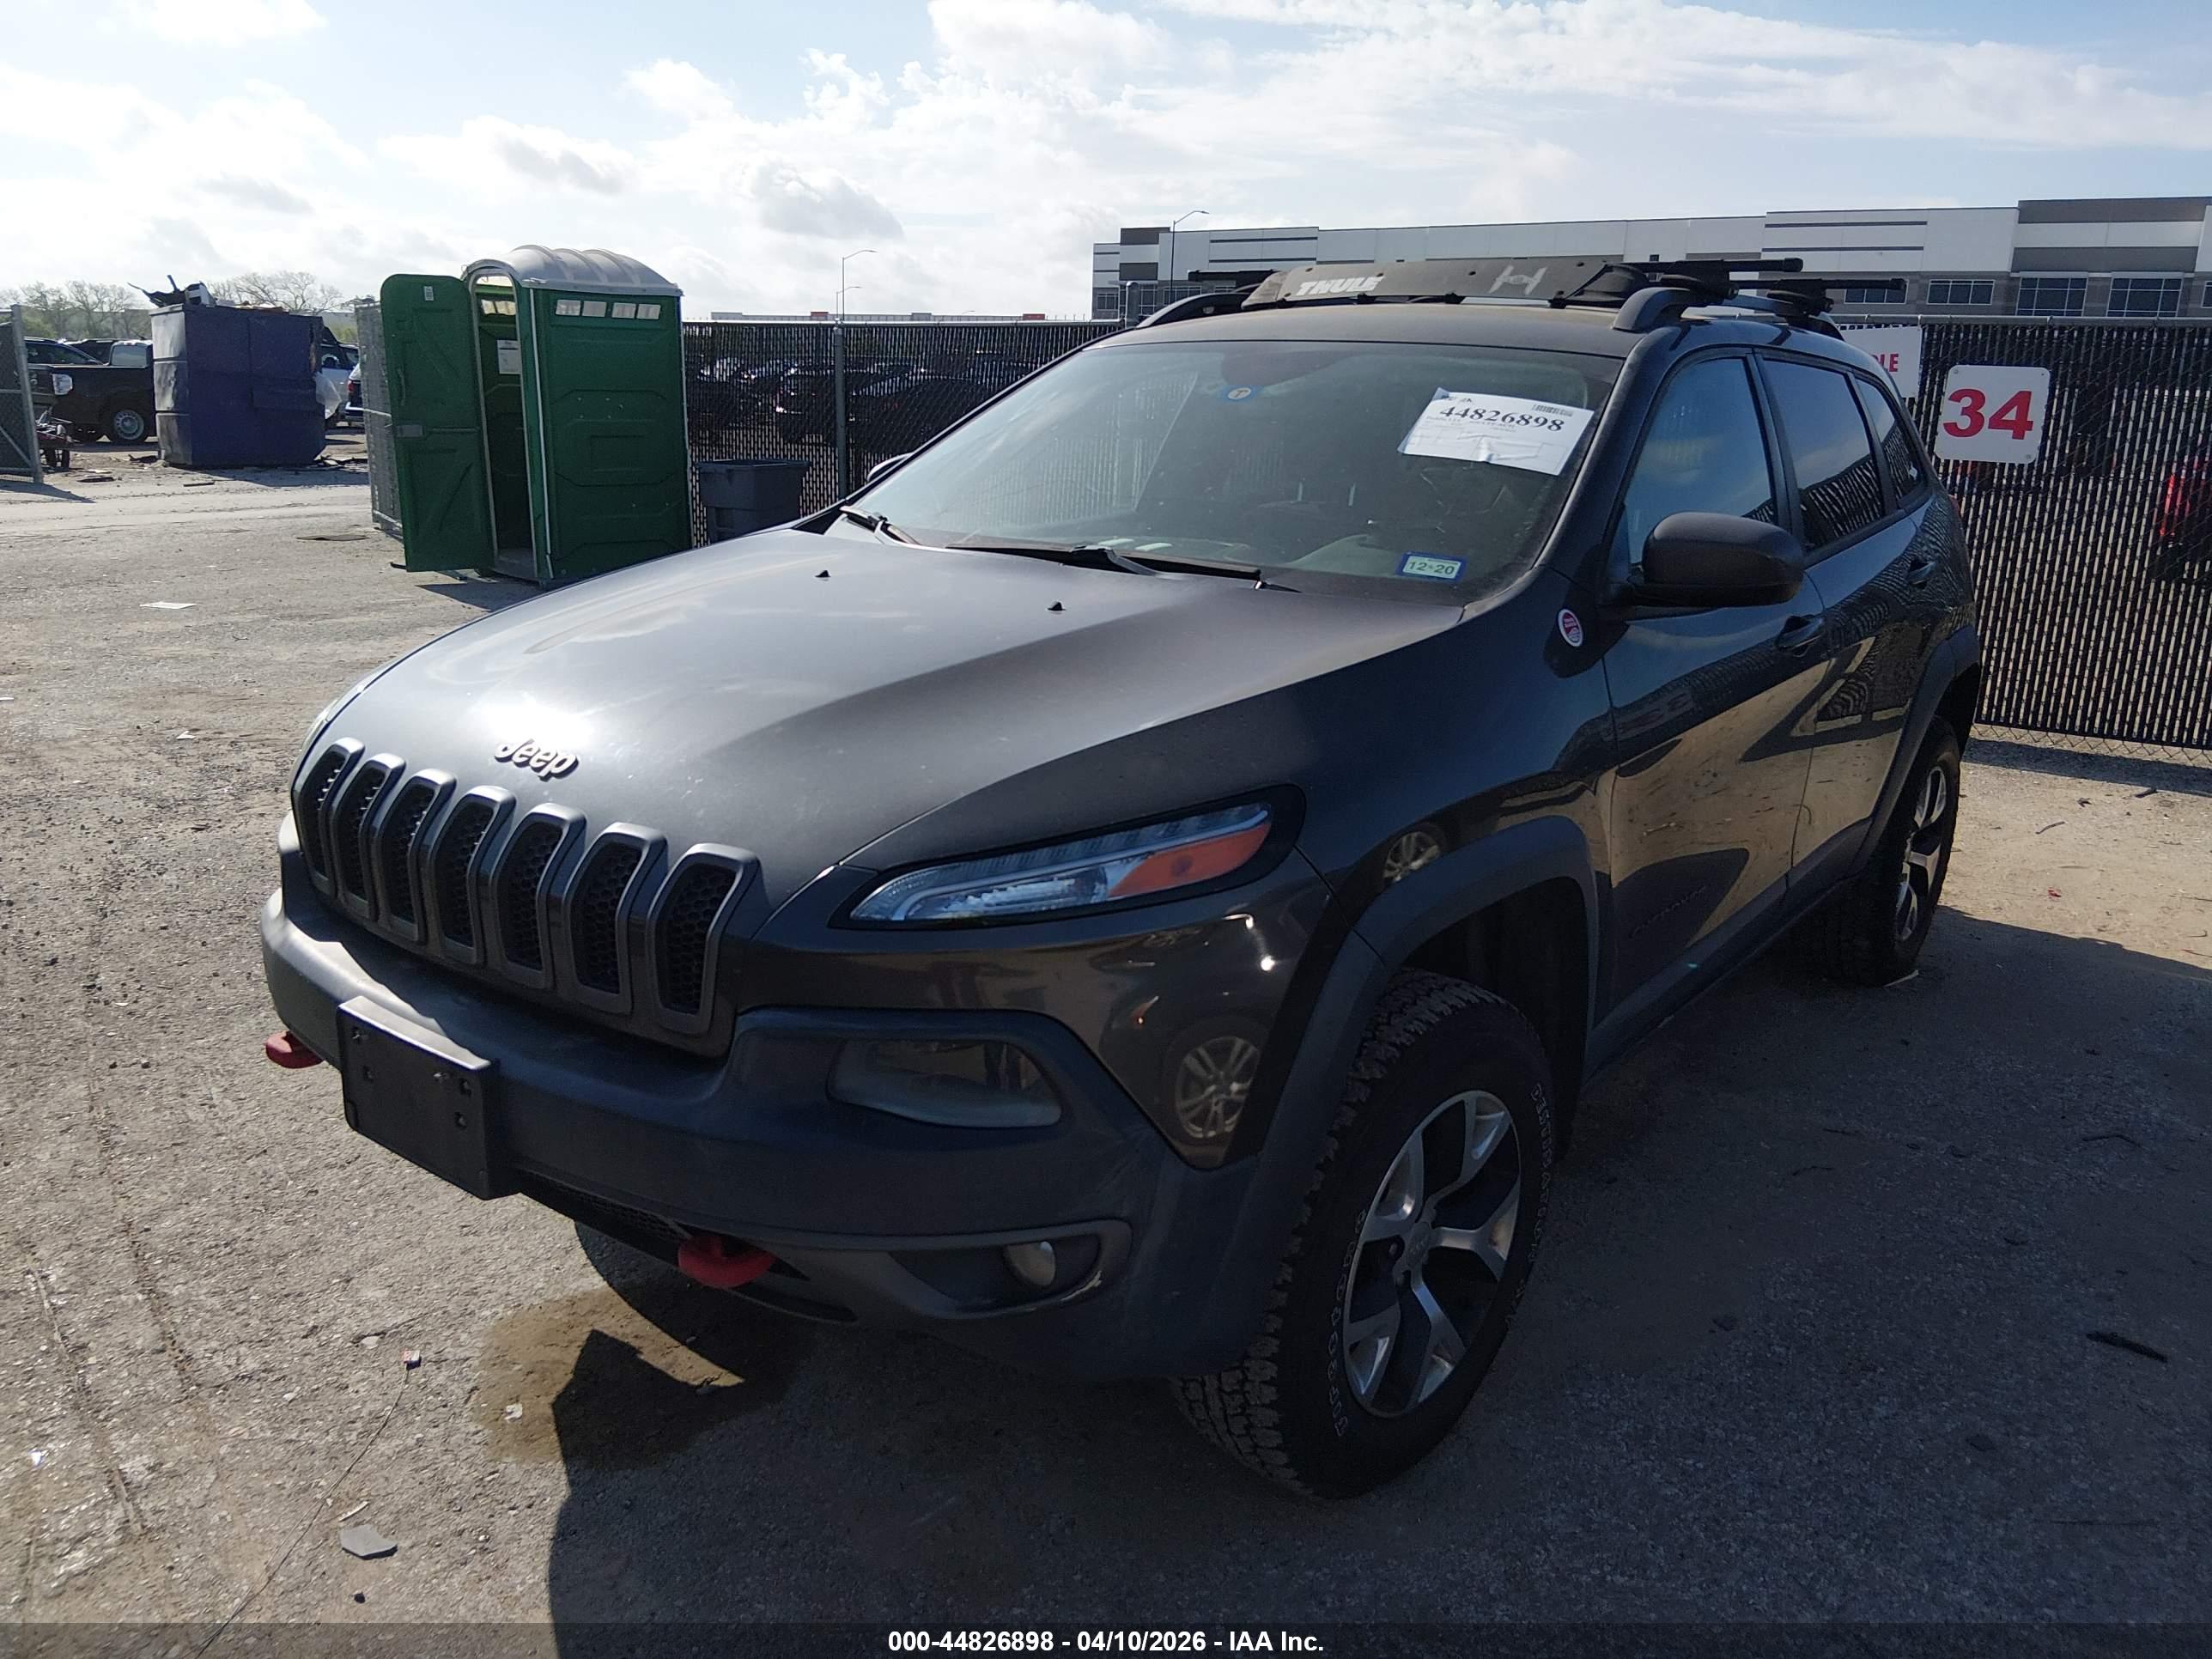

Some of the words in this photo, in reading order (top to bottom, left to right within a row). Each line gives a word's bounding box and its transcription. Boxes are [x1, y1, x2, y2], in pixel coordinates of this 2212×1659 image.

[1296, 276, 1385, 296] THULE
[1439, 405, 1565, 432] 44826898
[1942, 388, 2034, 441] 34
[495, 738, 580, 783] Jeep
